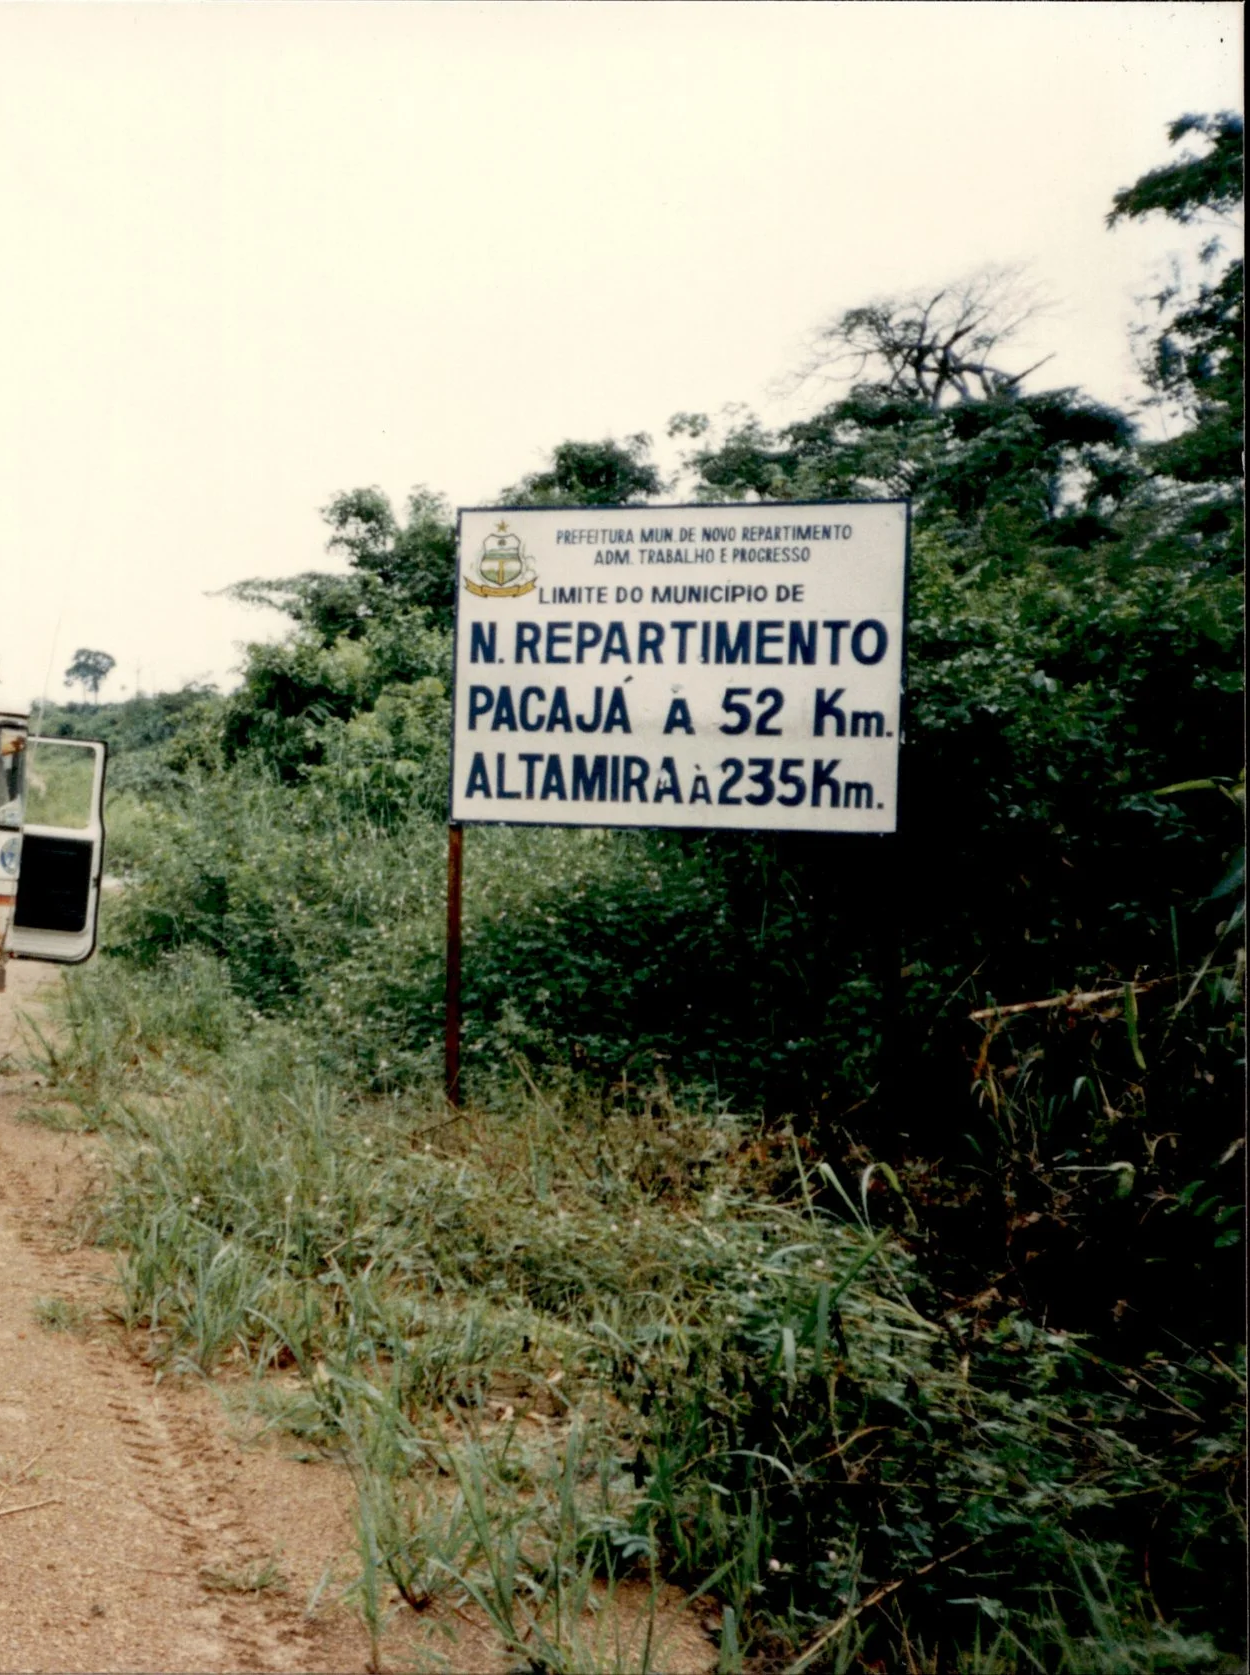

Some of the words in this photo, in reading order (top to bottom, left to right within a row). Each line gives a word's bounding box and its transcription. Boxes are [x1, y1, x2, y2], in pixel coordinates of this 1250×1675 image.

[556, 528, 635, 544] PREFEITURA
[679, 527, 696, 542] DE
[701, 526, 737, 542] NOVO
[741, 524, 853, 541] REPARTIMENTO
[594, 549, 634, 565] ADM.
[638, 547, 715, 564] TRABALHO
[720, 547, 727, 563] E
[732, 546, 811, 563] PROGRESSO
[538, 586, 608, 604] LIMITE
[615, 585, 643, 603] DO
[775, 584, 804, 602] DE
[470, 621, 505, 664] N.
[514, 618, 888, 666] REPARTIMENTO
[468, 674, 633, 734] PACAJÁ
[718, 686, 785, 736] 52
[813, 687, 894, 738] Km.
[465, 751, 683, 804] ALTAMIRA
